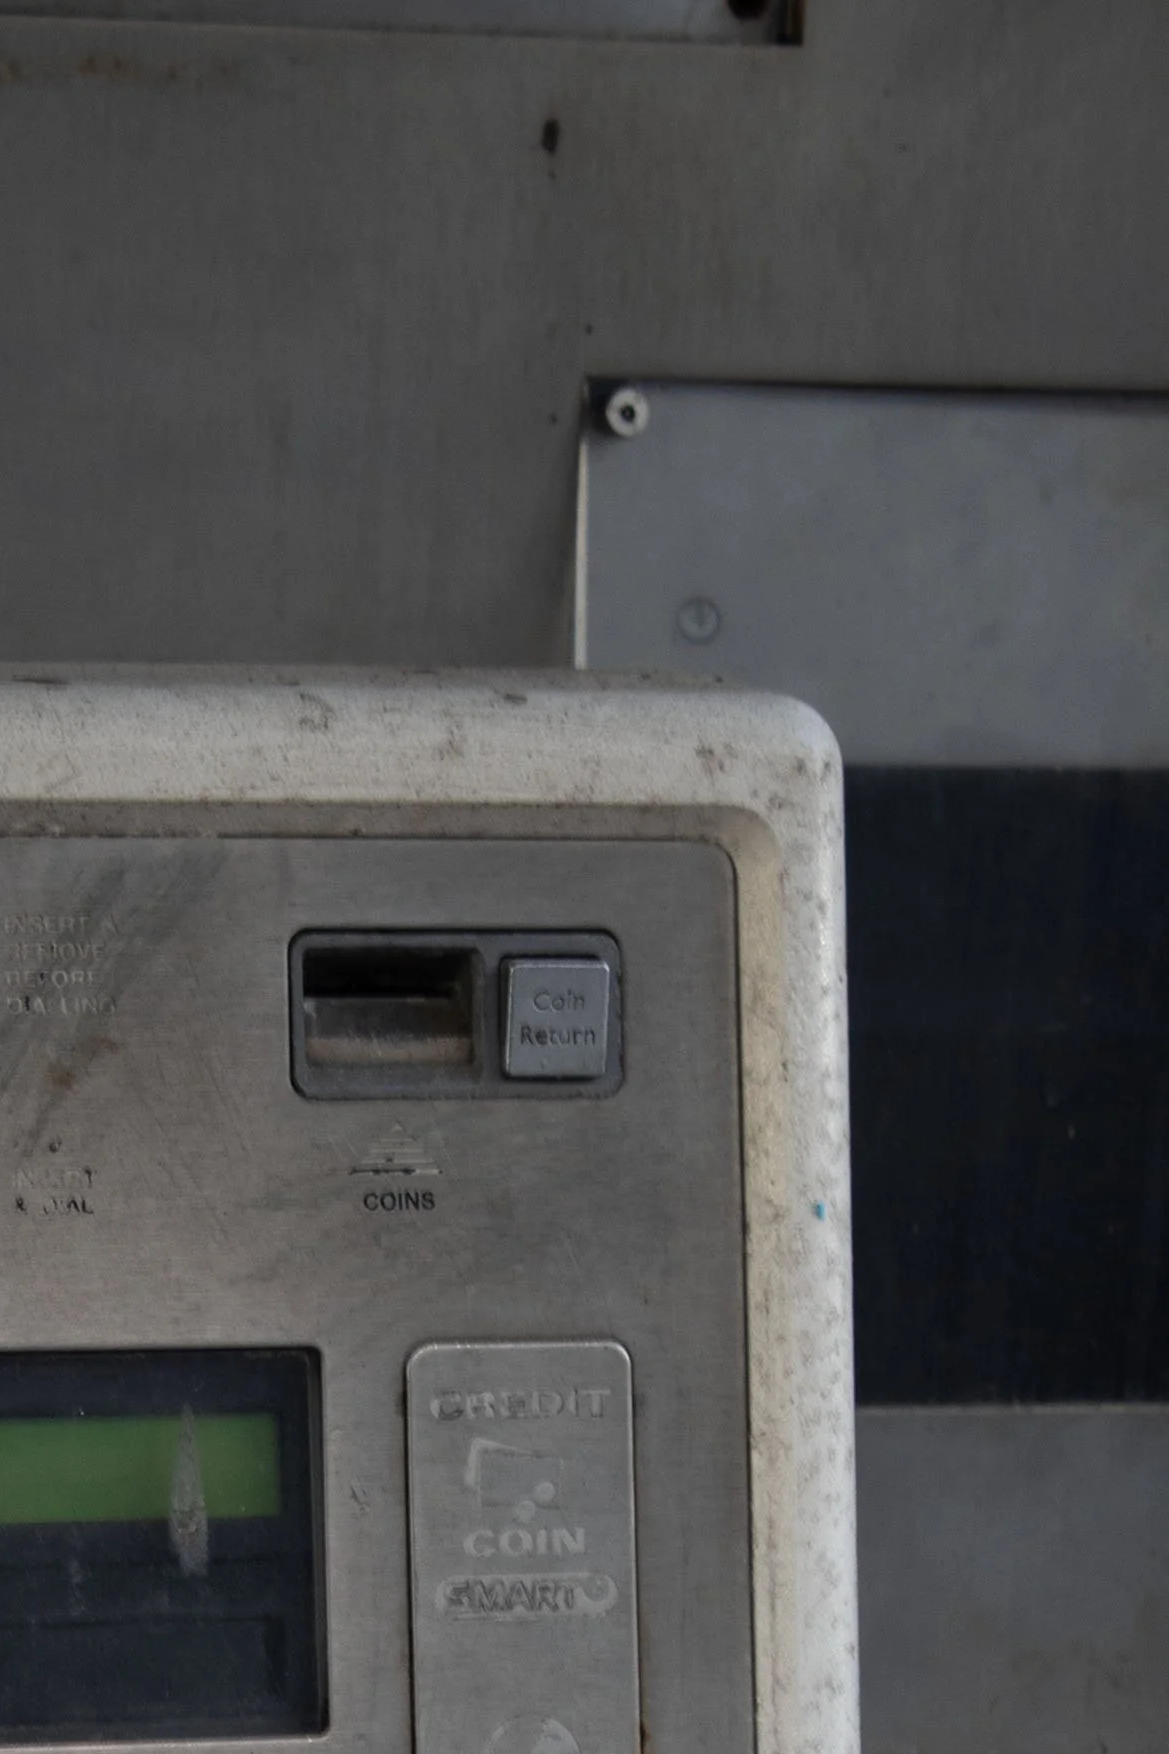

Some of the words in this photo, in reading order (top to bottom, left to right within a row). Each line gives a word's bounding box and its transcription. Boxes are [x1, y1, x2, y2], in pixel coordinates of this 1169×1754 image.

[533, 988, 585, 1013] Coin
[520, 1024, 596, 1047] Return
[363, 1190, 436, 1212] COINS
[430, 1388, 611, 1420] CREDIT
[462, 1526, 587, 1557] COIN
[443, 1579, 580, 1612] SMART
